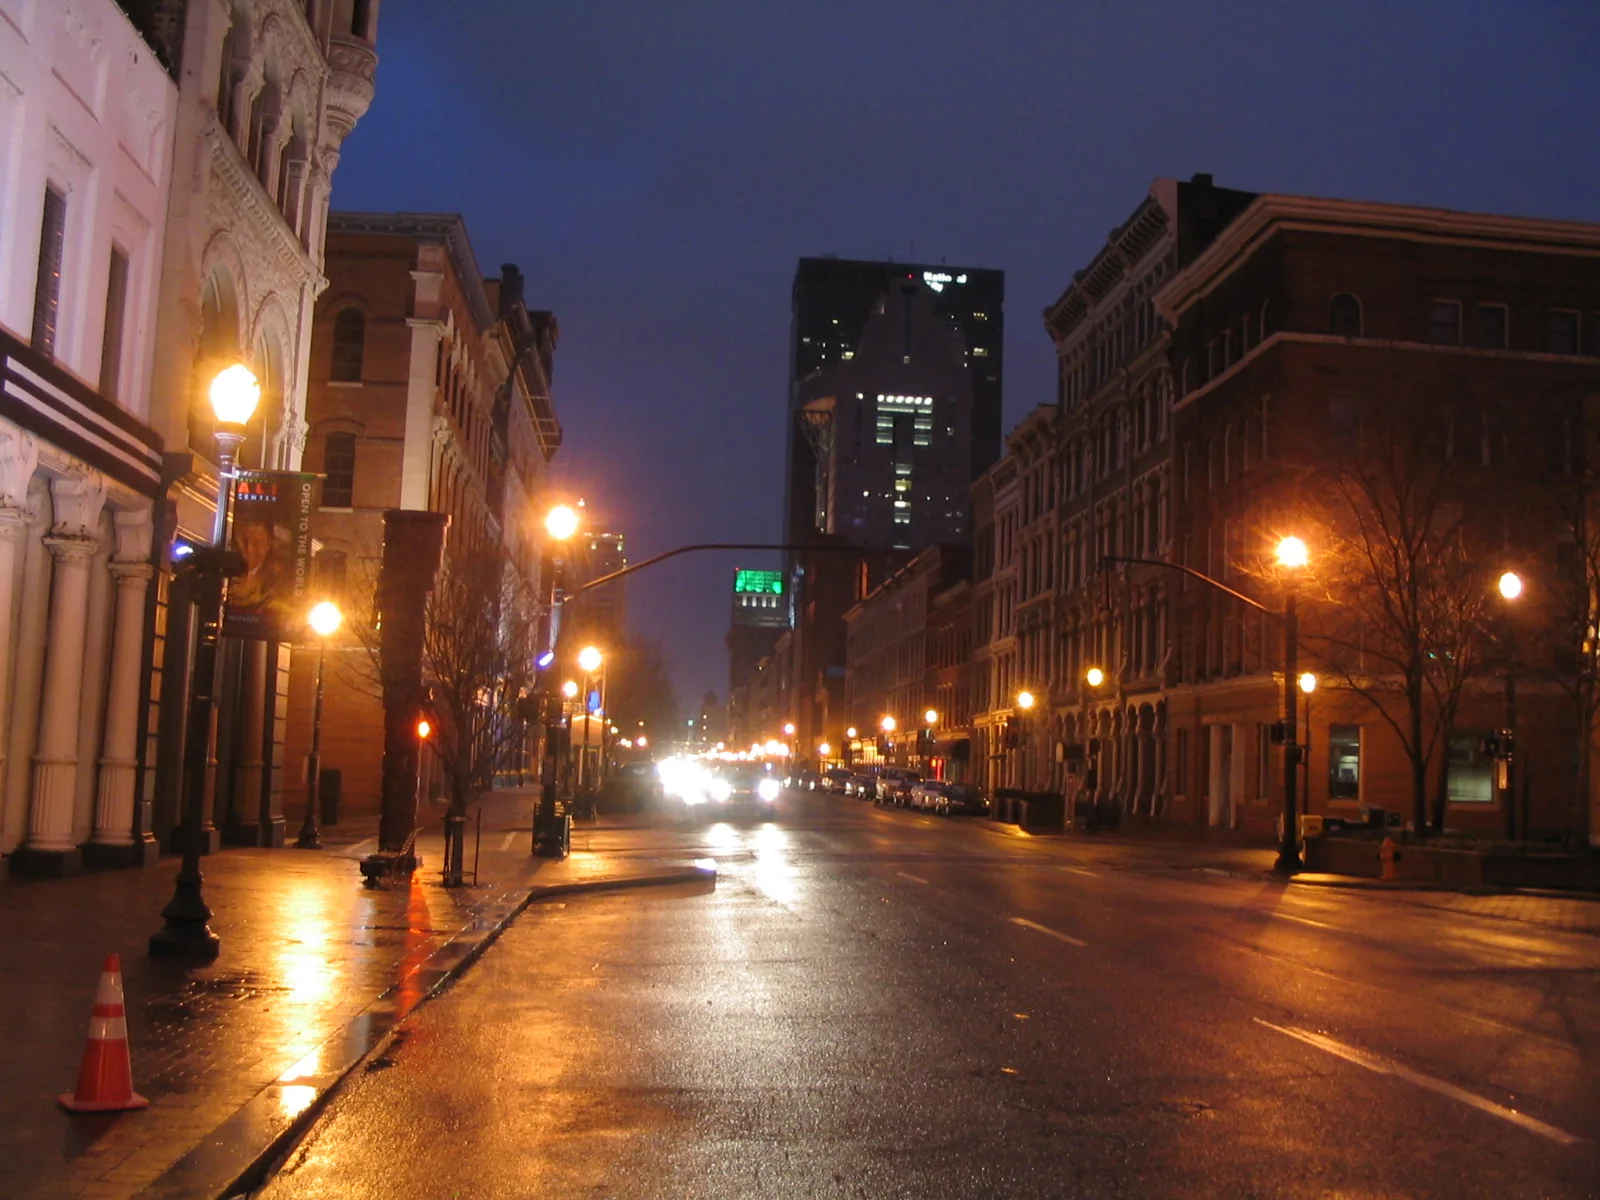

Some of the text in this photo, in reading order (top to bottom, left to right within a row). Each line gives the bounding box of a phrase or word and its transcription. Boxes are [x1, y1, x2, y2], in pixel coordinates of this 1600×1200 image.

[923, 271, 967, 284] Natioal
[238, 481, 278, 495] ALI
[294, 483, 311, 597] OPEN TO THE WORLD
